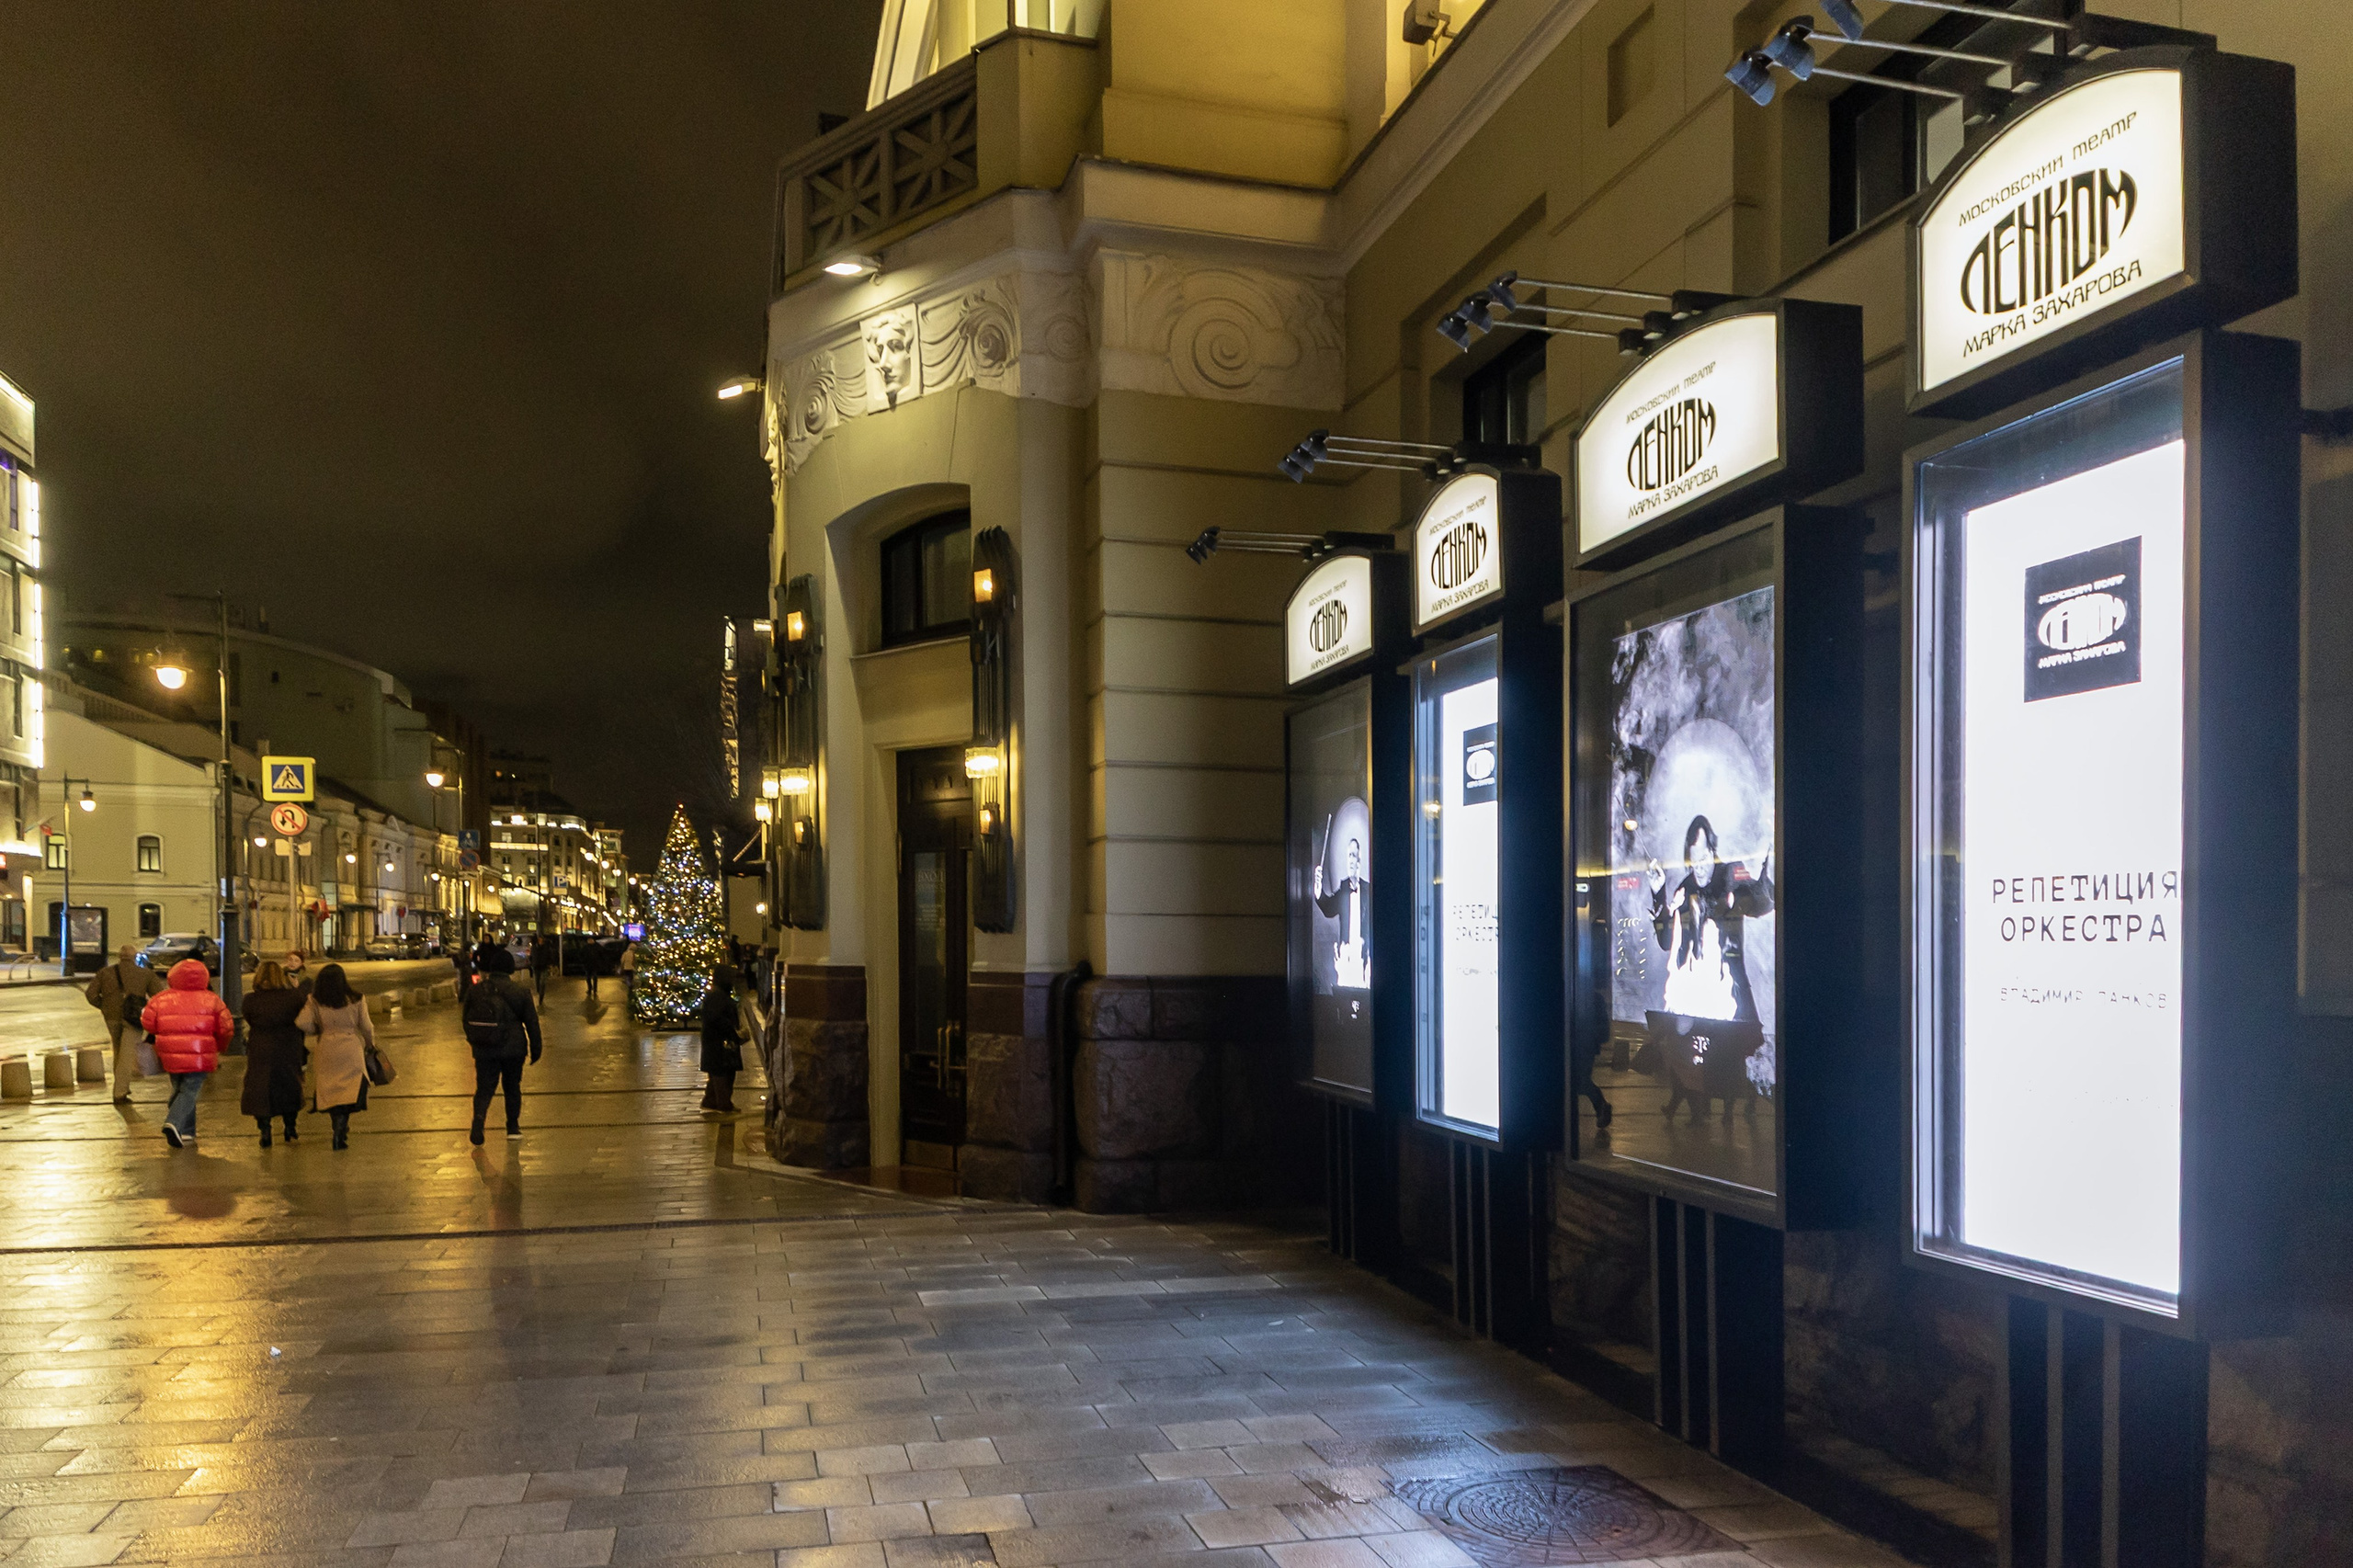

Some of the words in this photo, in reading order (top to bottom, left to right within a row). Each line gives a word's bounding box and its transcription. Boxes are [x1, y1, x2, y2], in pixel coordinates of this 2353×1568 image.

[1961, 167, 2138, 314] ЛЕНКОМ
[1963, 313, 2026, 358] МАРКА
[2032, 258, 2143, 324] ЗАХАРОВА
[1627, 398, 1717, 491] ЛЕНКОМ
[1628, 493, 1661, 519] МАРКА
[1663, 465, 1719, 502] ЗАХАРОВА
[1430, 522, 1487, 589] ЛЕНКОМ
[1993, 870, 2178, 904] РЕПЕТИЦИЯ
[2000, 915, 2167, 942] ОРКЕСТРА
